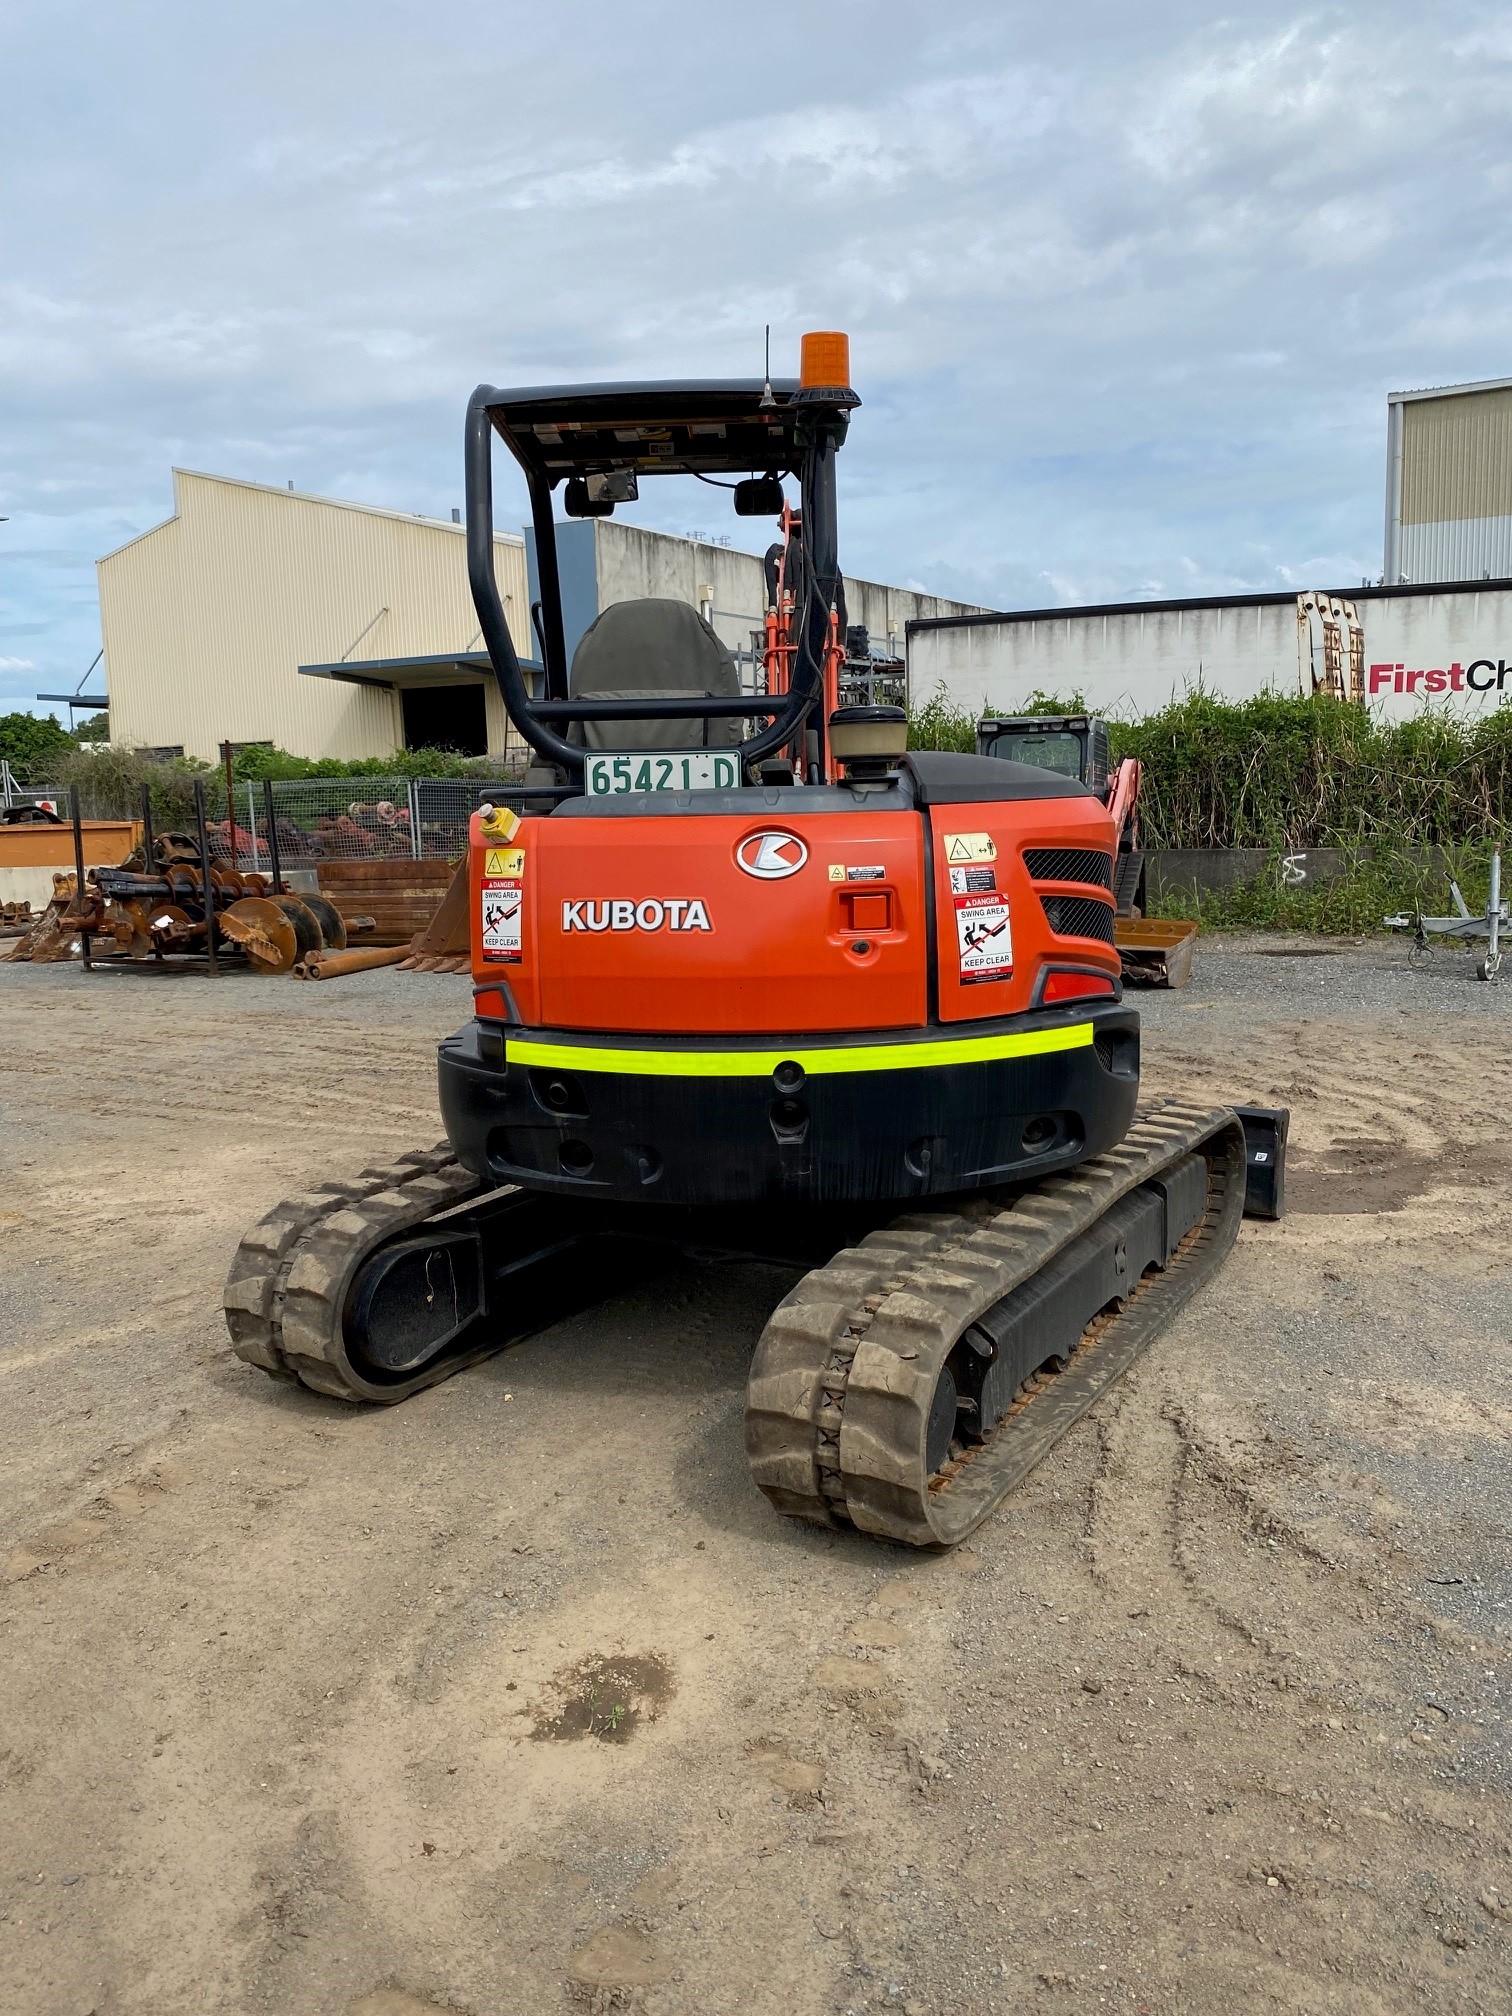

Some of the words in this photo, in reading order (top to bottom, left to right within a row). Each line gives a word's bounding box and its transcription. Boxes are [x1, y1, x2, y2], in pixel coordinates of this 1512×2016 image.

[485, 891, 502, 899] SWING
[503, 891, 518, 899] AREA
[971, 897, 1000, 907] DANGER
[562, 899, 711, 931] KUBOTA
[960, 909, 985, 919] SWING
[986, 907, 1006, 916] AREA
[485, 938, 499, 946] KEEP
[499, 938, 518, 946] CLEAR
[964, 957, 985, 967] KEEP
[986, 955, 1010, 966] CLEAR
